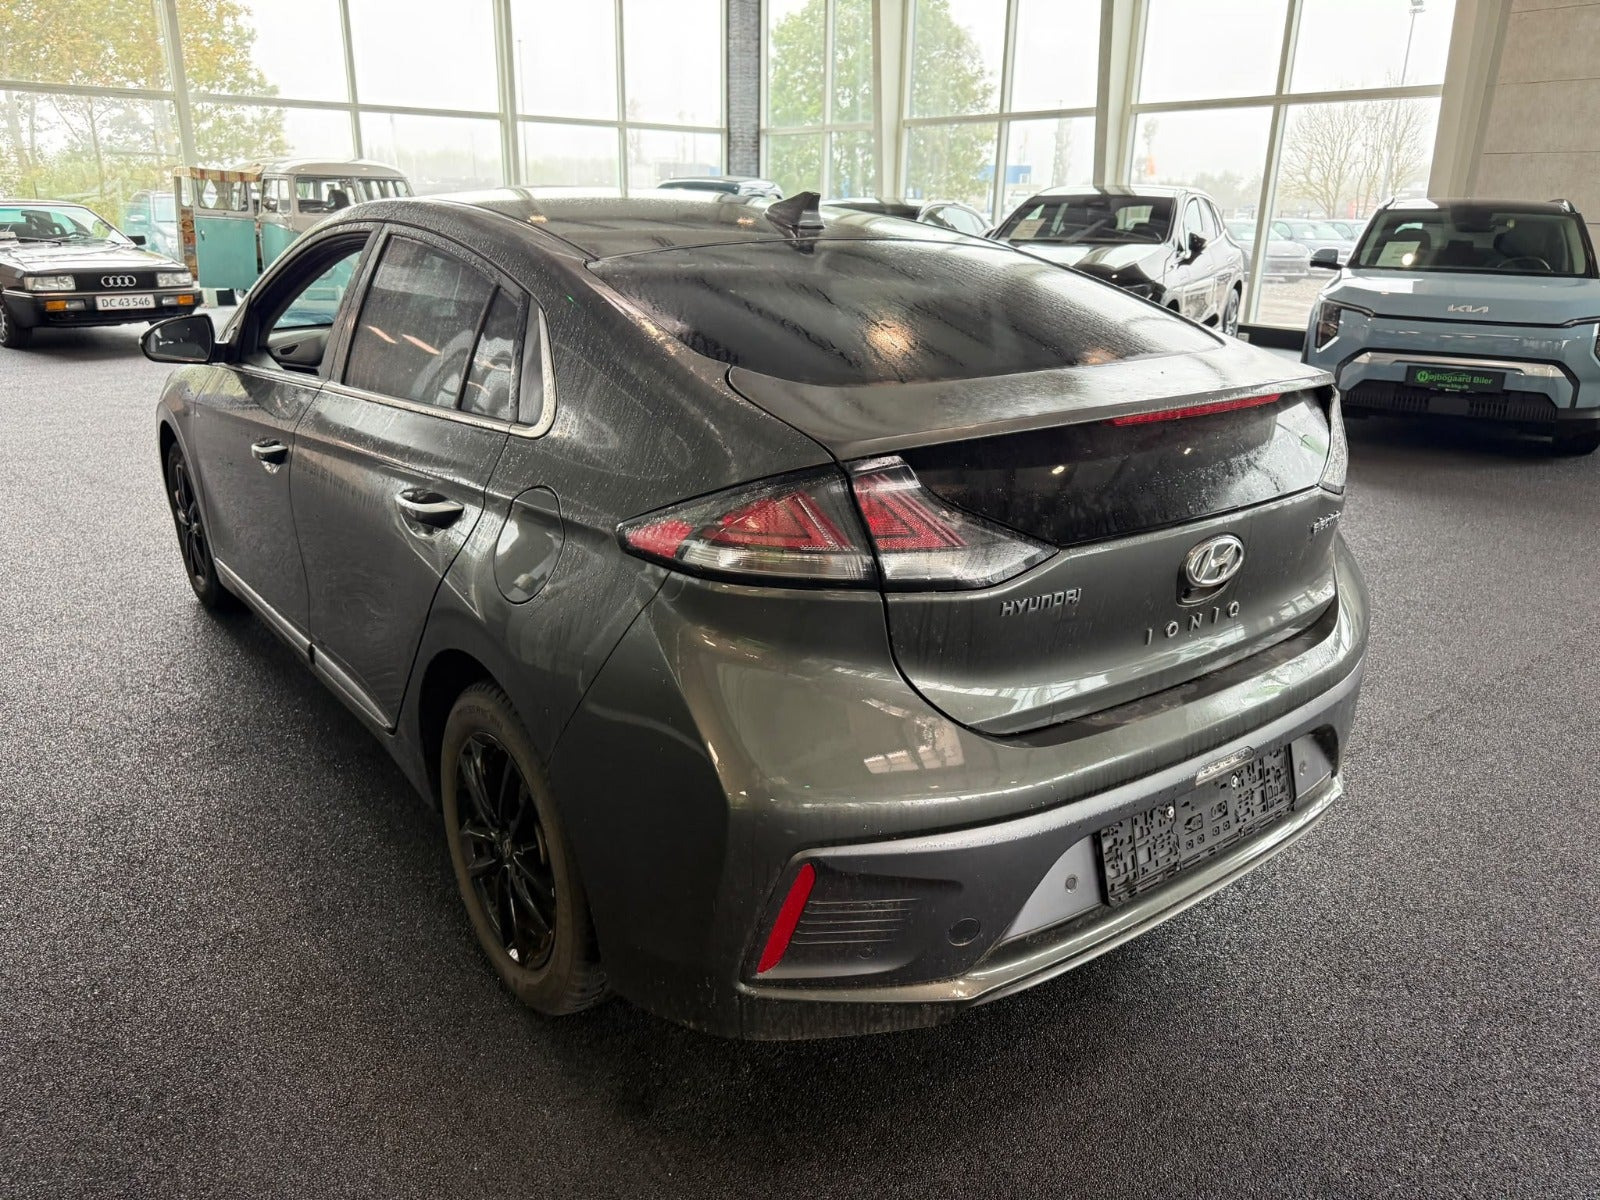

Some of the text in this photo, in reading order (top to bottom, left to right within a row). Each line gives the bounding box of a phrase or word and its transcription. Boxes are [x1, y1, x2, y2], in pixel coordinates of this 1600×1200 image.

[102, 296, 151, 308] DC 43 546
[1447, 304, 1489, 313] KIA
[1001, 588, 1082, 617] HYUNDAI
[1145, 600, 1240, 647] IONIQ
